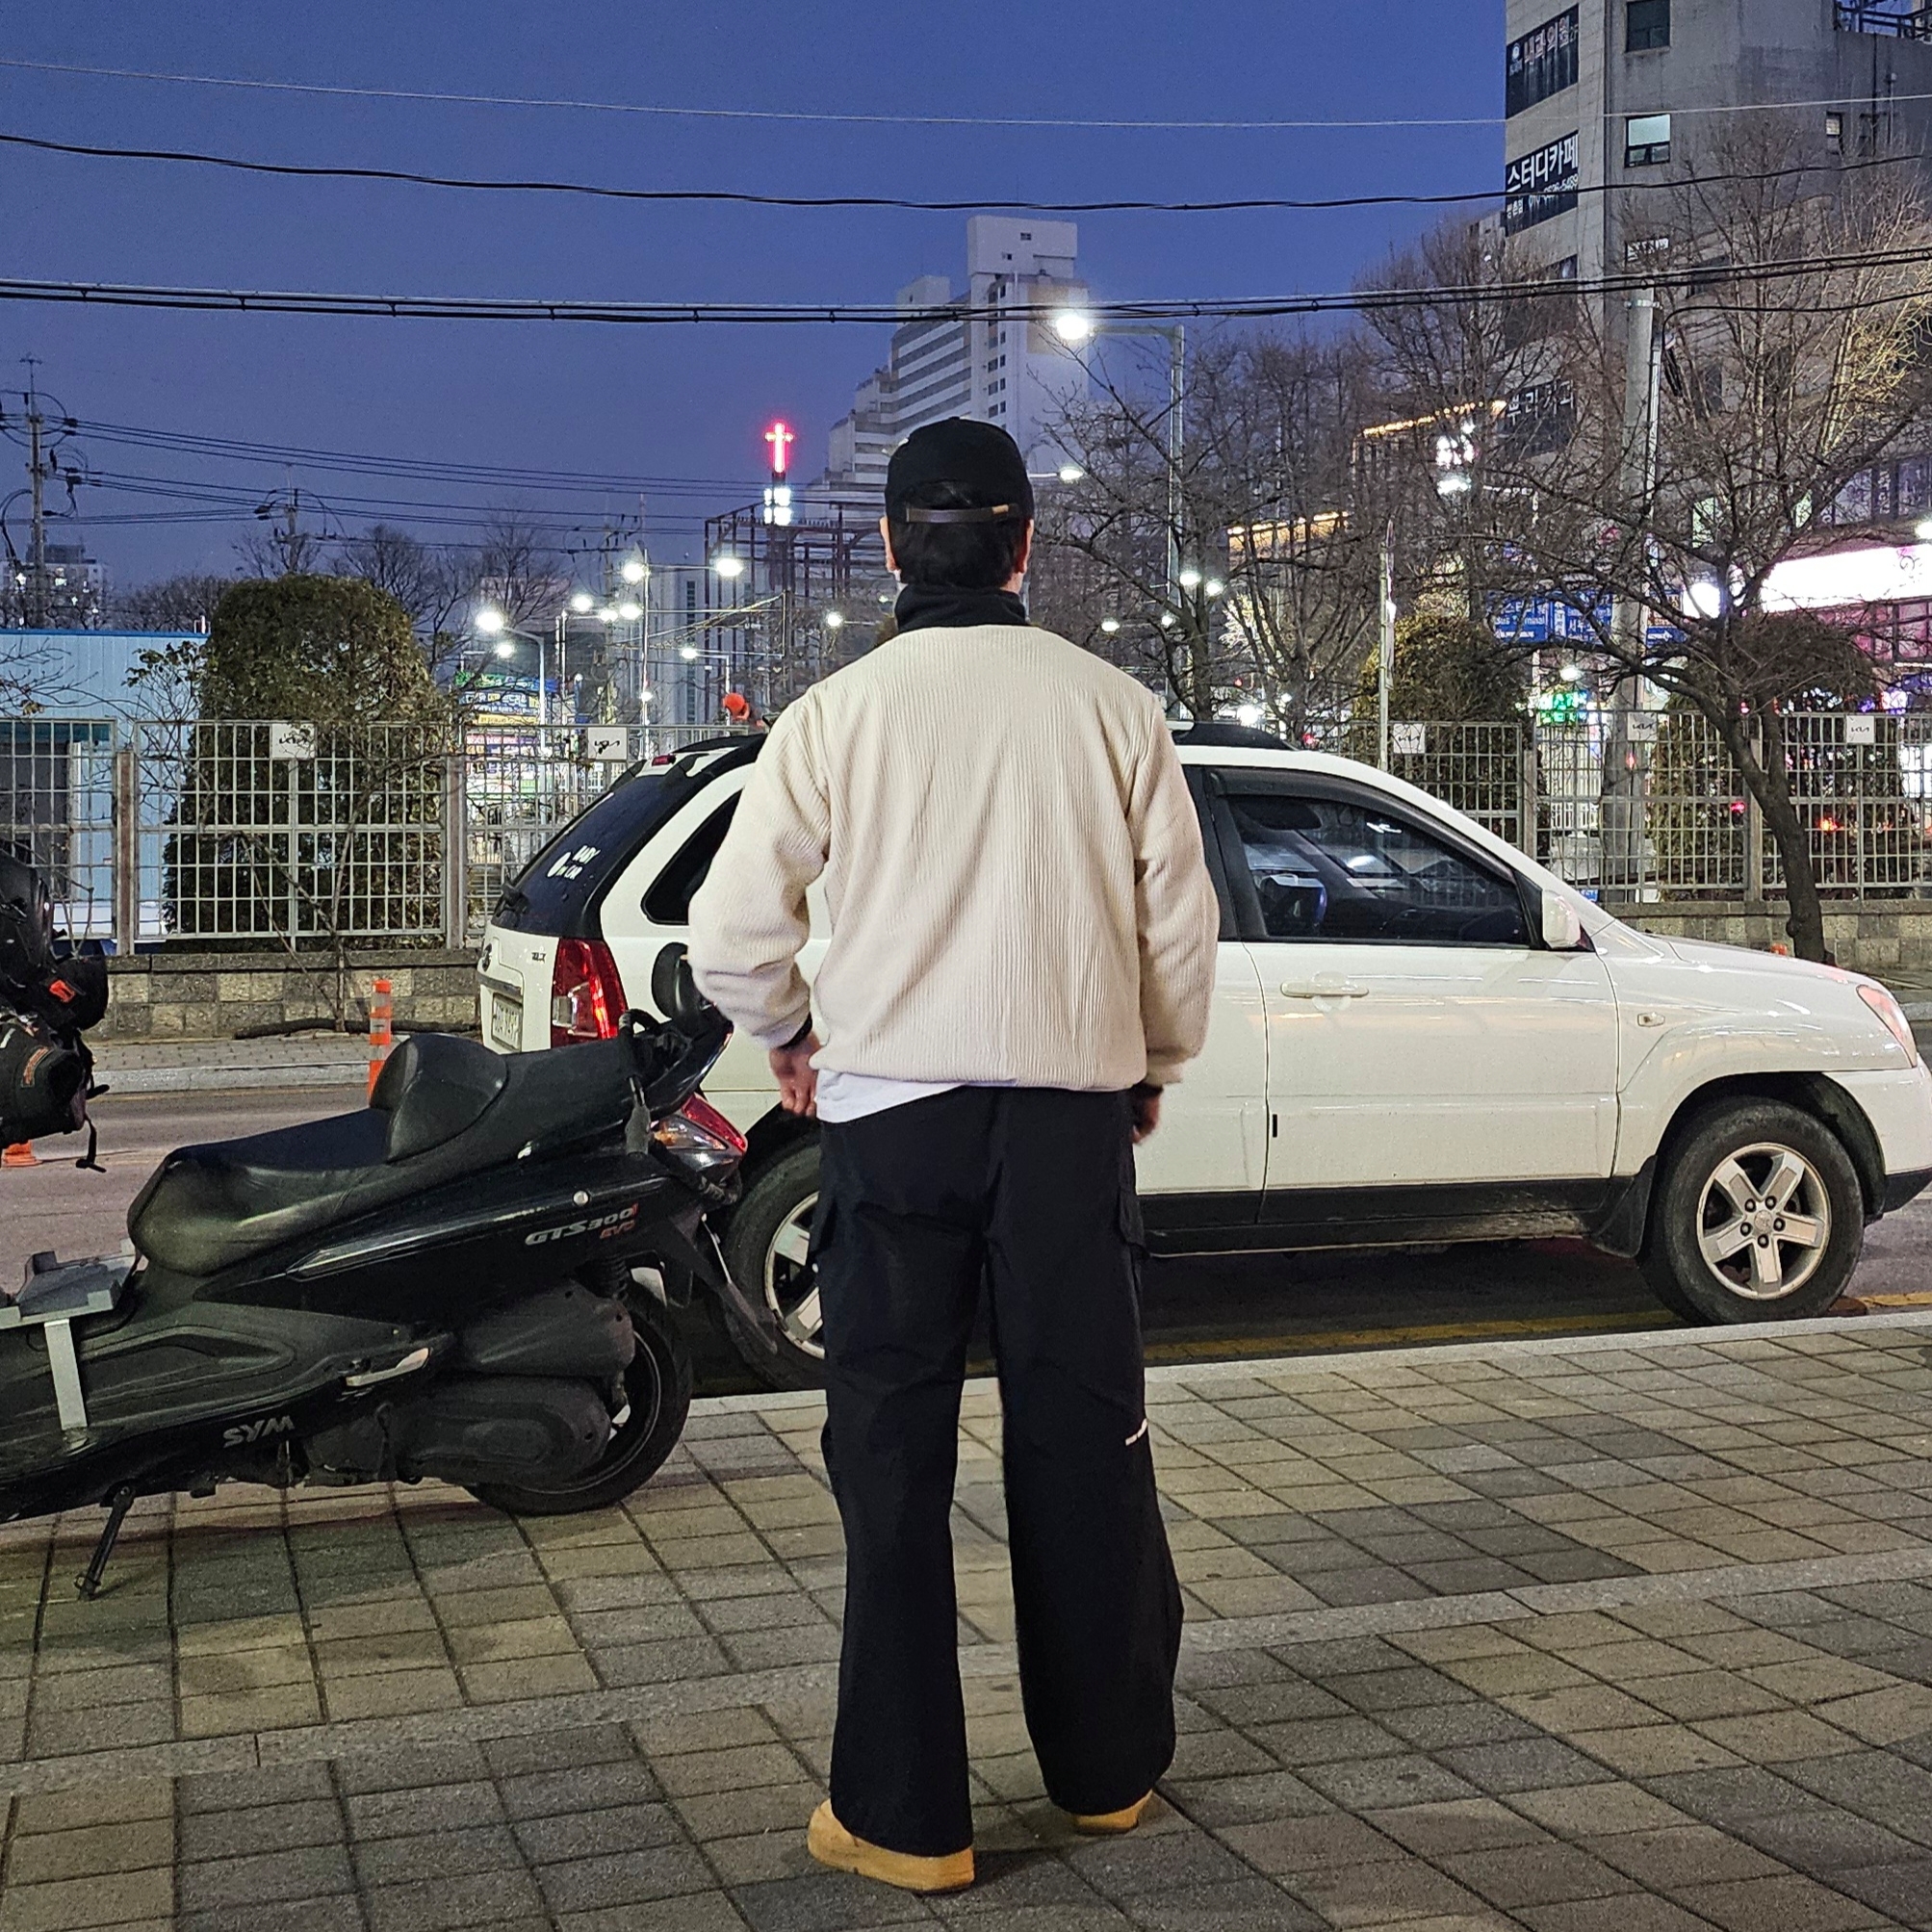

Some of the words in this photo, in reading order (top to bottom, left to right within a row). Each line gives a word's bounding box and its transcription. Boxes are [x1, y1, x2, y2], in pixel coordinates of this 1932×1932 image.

[1524, 14, 1569, 65] 내과의원
[1507, 135, 1579, 193] 스터디카페
[223, 1415, 295, 1449] SYM
